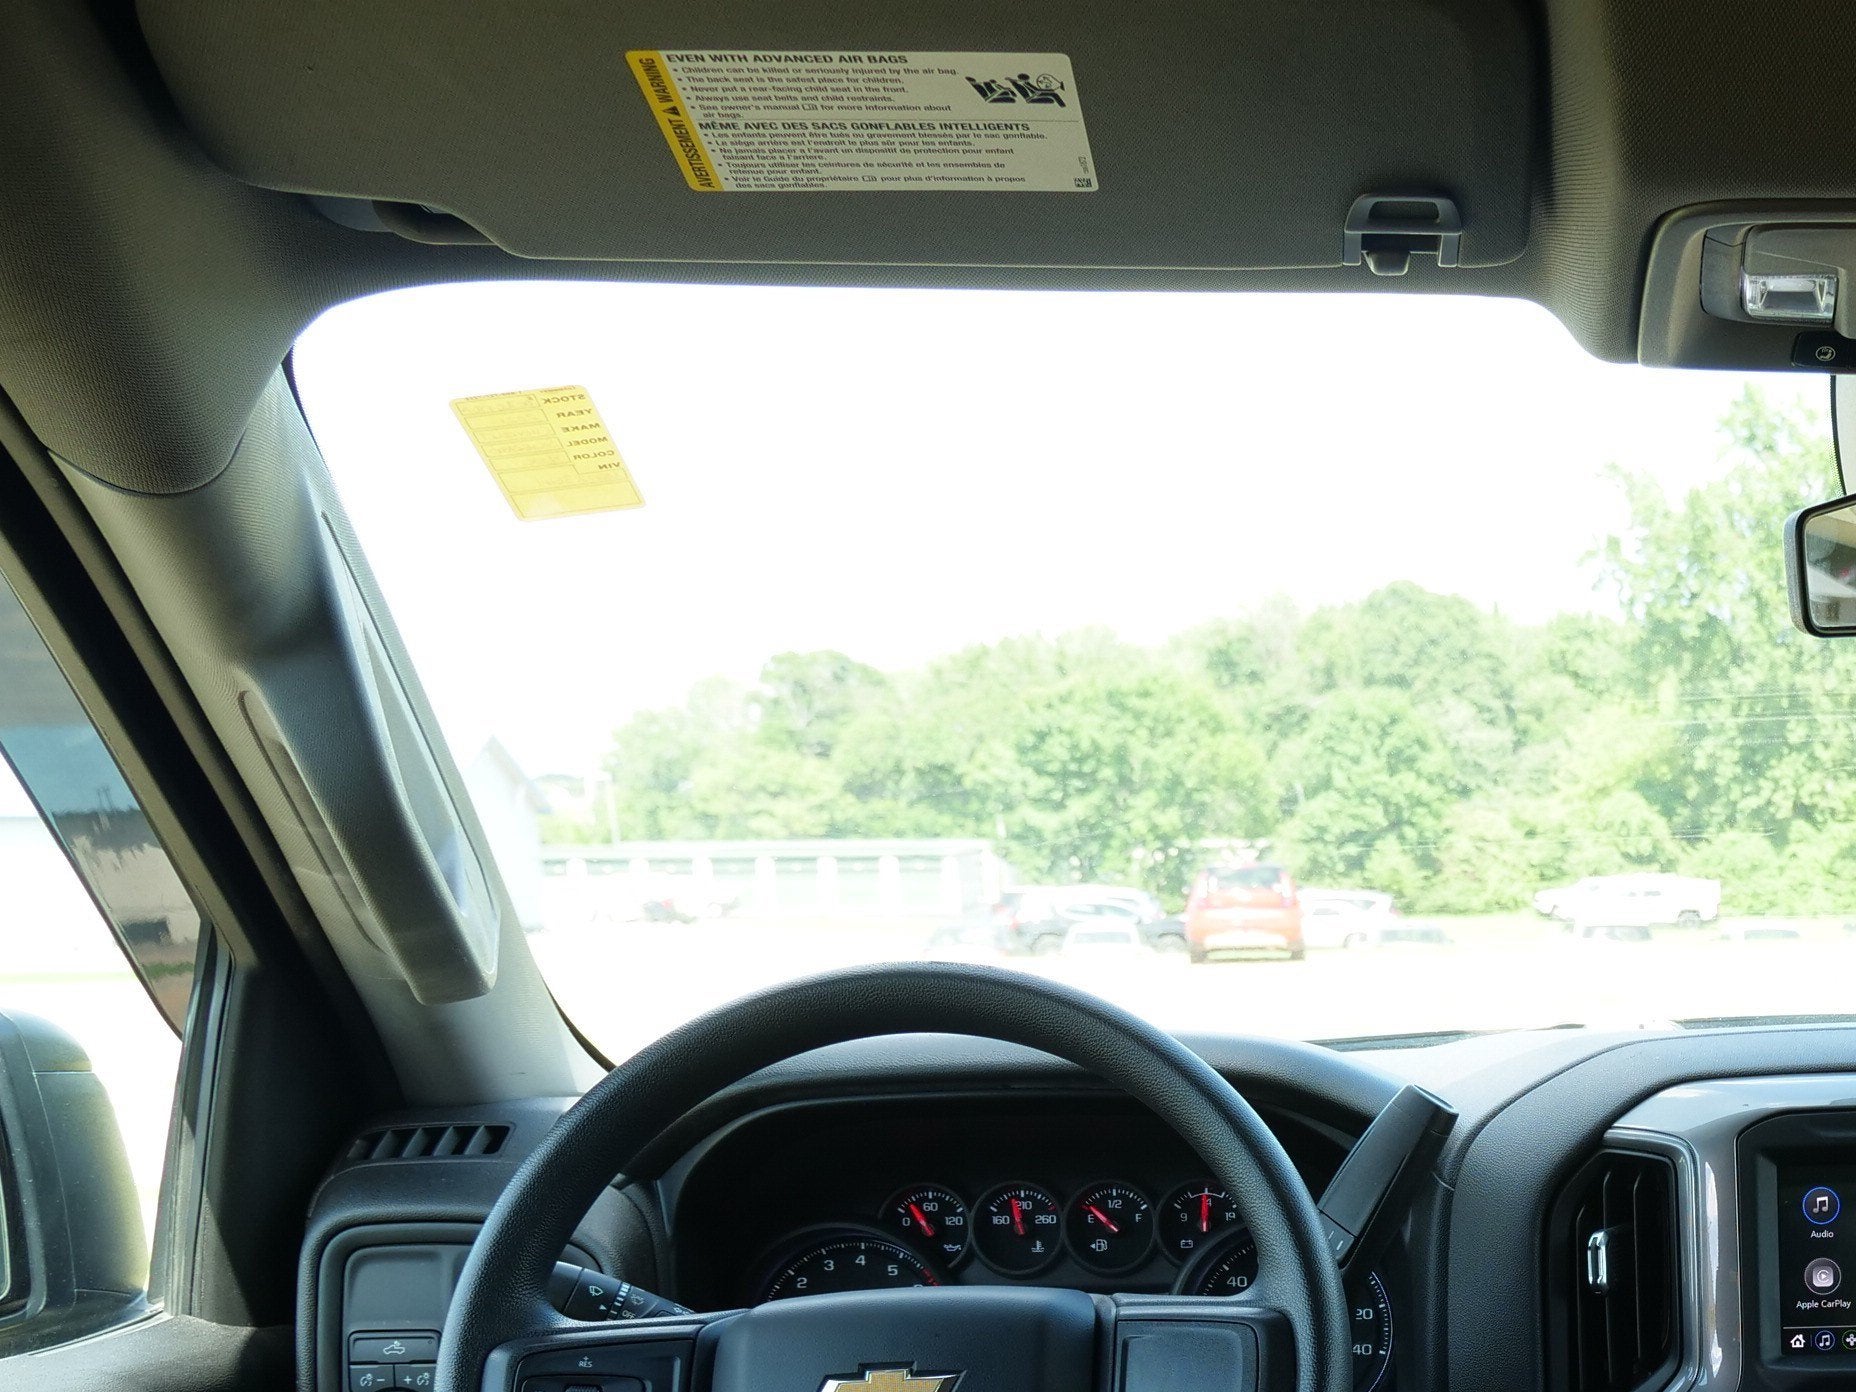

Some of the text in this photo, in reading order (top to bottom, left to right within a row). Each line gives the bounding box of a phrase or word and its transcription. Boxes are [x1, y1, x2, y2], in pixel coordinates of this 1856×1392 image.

[666, 54, 908, 64] EVEN WITH ADVANCED AIR BAGS
[681, 66, 723, 74] Children
[805, 67, 849, 75] seriously
[851, 67, 887, 75] injured
[889, 68, 900, 76] by
[937, 68, 959, 76] bag.
[639, 58, 674, 104] WARNING
[698, 121, 1030, 132] MÊME AVEC DES SACS GONFLABLES INTELLIGENTS
[668, 117, 715, 189] AVERTISSEMENT
[923, 1202, 938, 1212] 60
[1108, 1200, 1122, 1209] 1/2
[902, 1217, 911, 1227] 0
[945, 1216, 963, 1226] 120
[992, 1215, 1010, 1225] 160
[1035, 1215, 1057, 1225] 260
[1088, 1214, 1094, 1223] E
[1135, 1213, 1142, 1223] F
[1180, 1213, 1188, 1222] 9
[1225, 1212, 1237, 1222] 19
[1810, 1230, 1834, 1239] Audio
[824, 1260, 834, 1271] 3
[855, 1255, 866, 1266] 4
[887, 1264, 898, 1276] 5
[797, 1278, 807, 1289] 2
[1227, 1276, 1248, 1288] 40
[1796, 1299, 1852, 1310] Apple CarPlay
